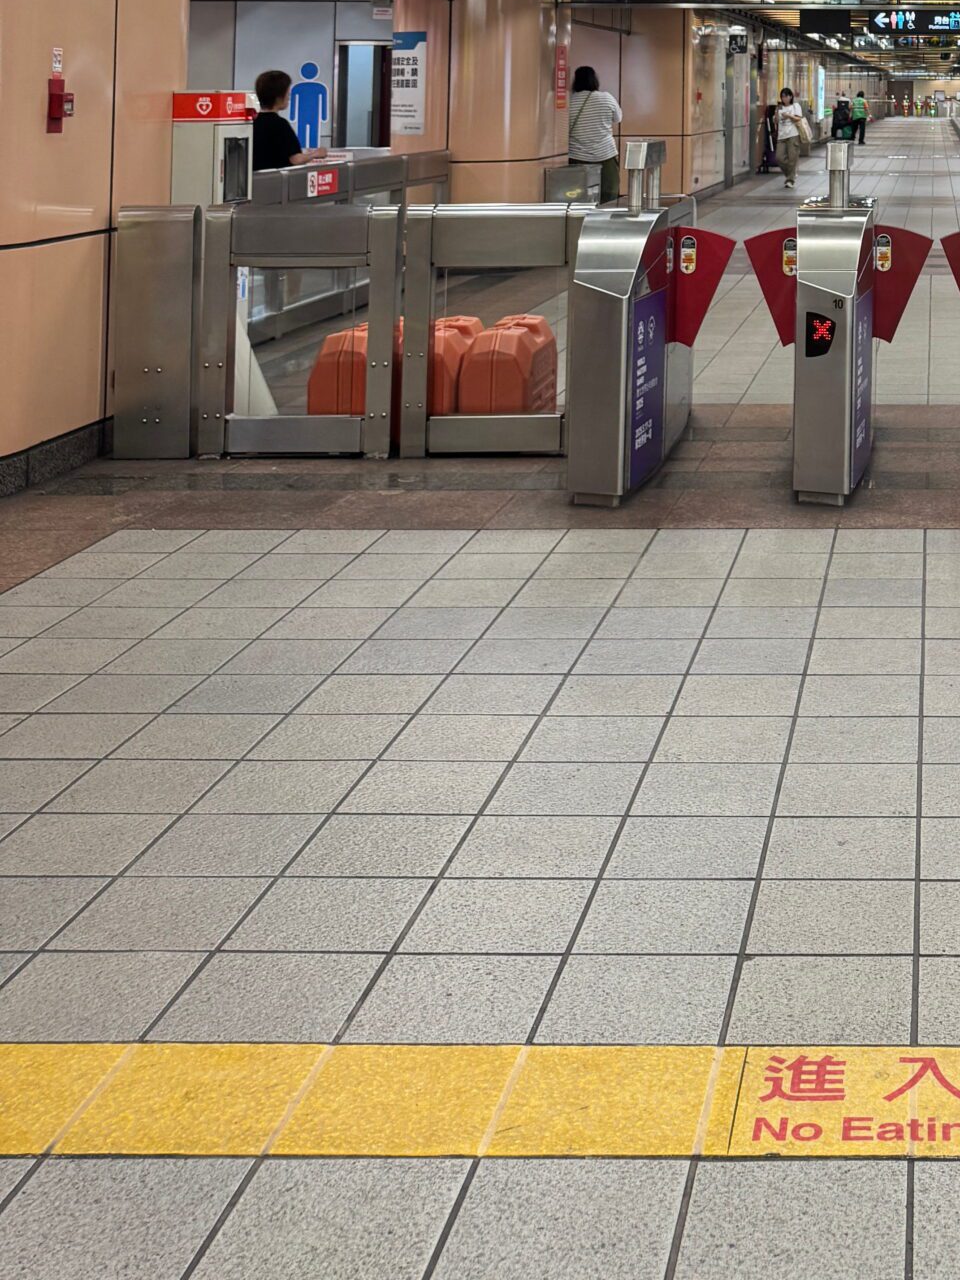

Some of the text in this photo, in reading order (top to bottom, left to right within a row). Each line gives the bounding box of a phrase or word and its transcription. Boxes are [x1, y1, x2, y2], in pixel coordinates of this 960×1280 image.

[934, 16, 949, 24] 月台
[832, 298, 844, 310] 10
[752, 1116, 823, 1141] No
